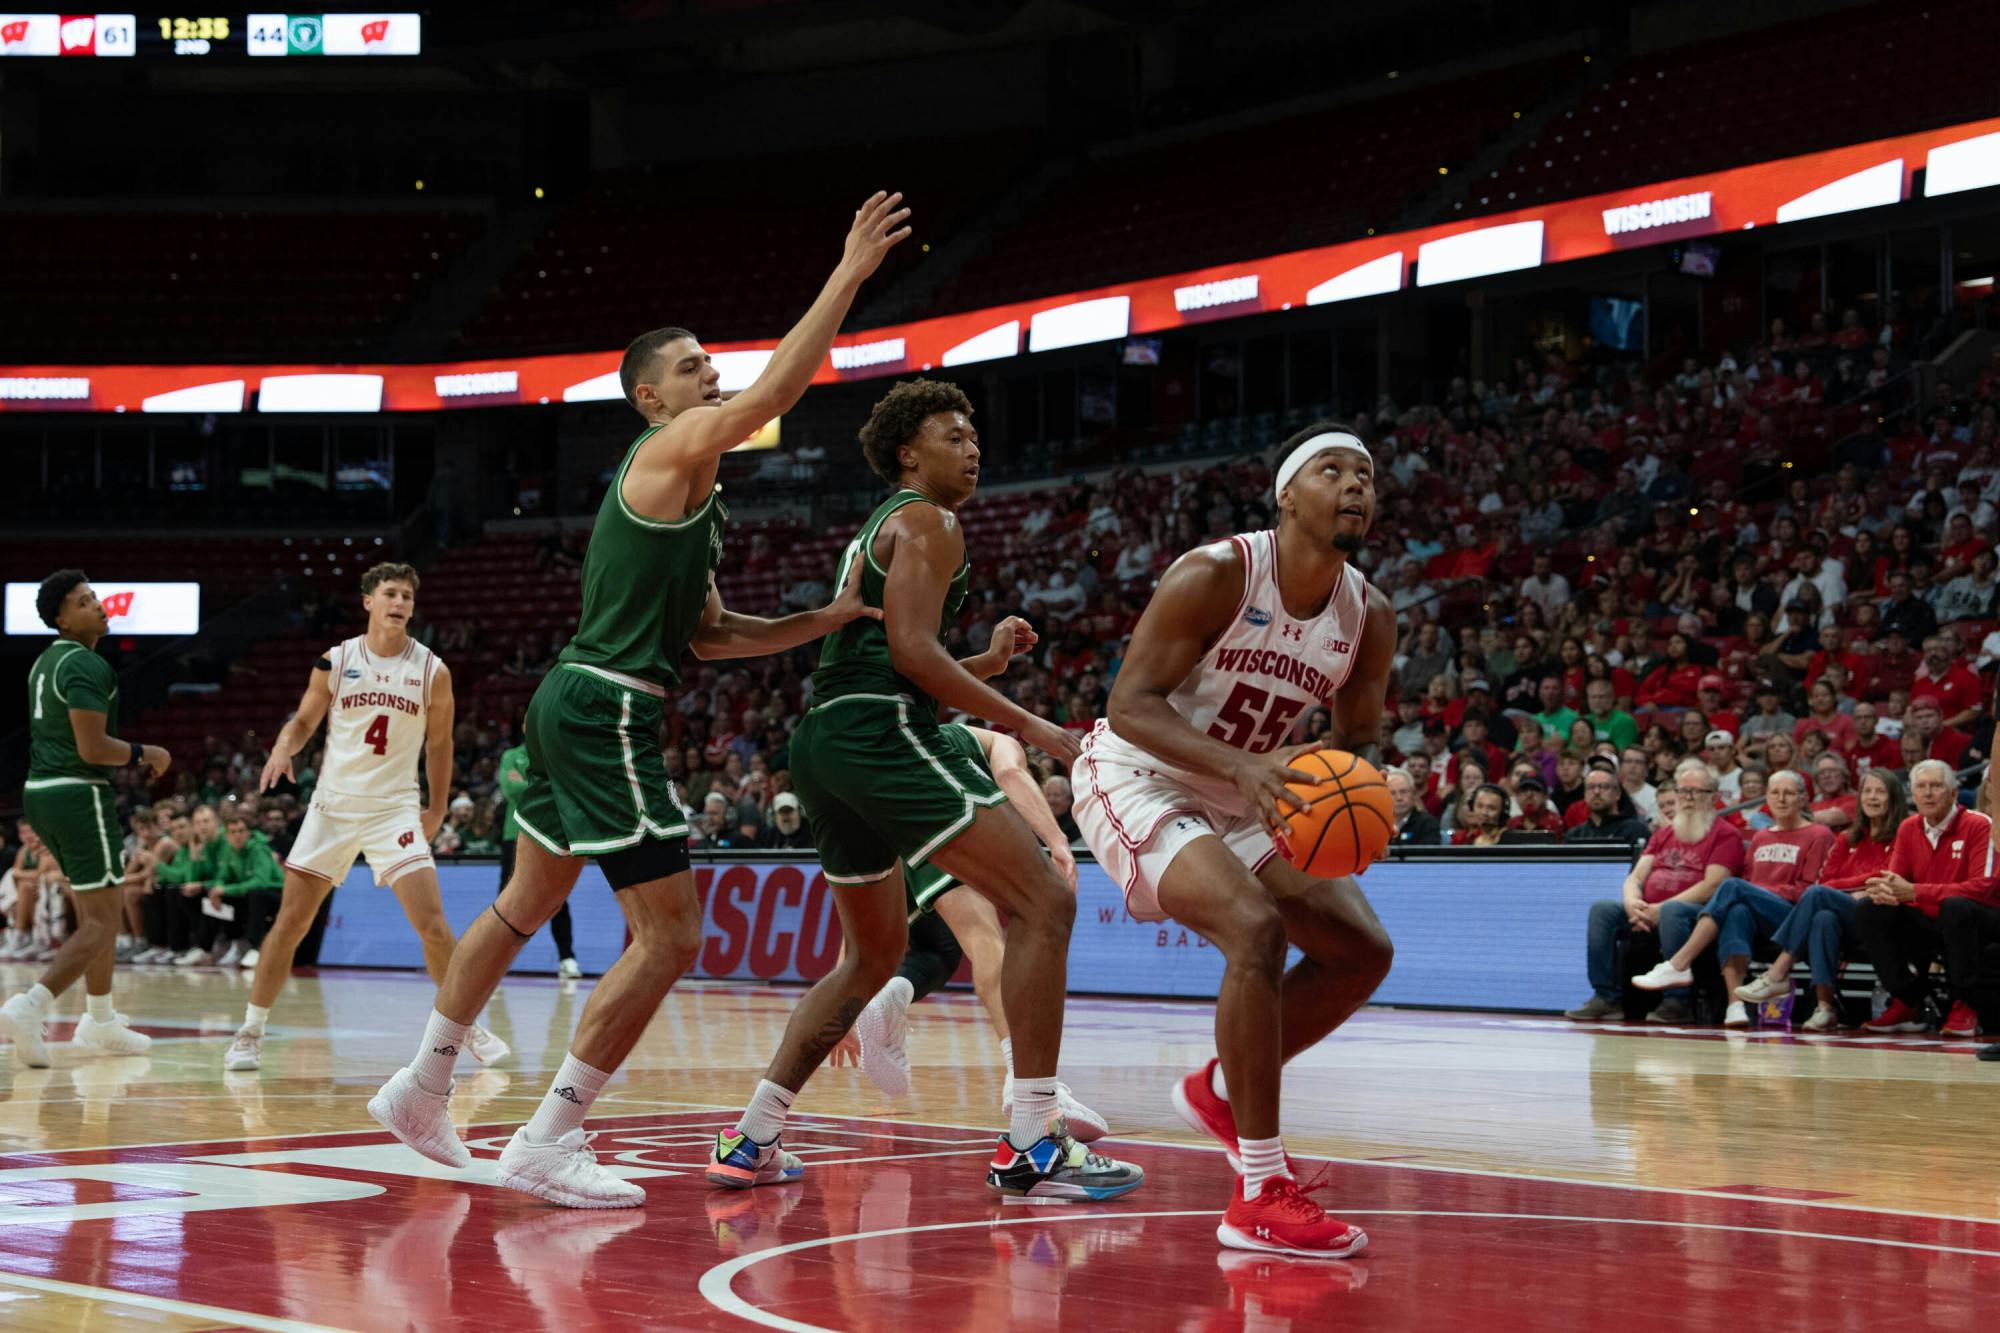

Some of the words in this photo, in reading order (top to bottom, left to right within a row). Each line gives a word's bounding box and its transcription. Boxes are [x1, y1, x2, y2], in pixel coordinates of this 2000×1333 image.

[103, 27, 128, 44] 61
[254, 27, 282, 42] 44
[1602, 191, 1711, 235] WISCONSIN
[1174, 274, 1259, 312] WISCONSIN
[34, 673, 45, 719] 1
[341, 692, 420, 717] WISCONSIN
[1207, 681, 1307, 754] 55
[364, 714, 390, 756] 4
[433, 1046, 459, 1057] PEAK
[554, 1088, 584, 1106] PEAK
